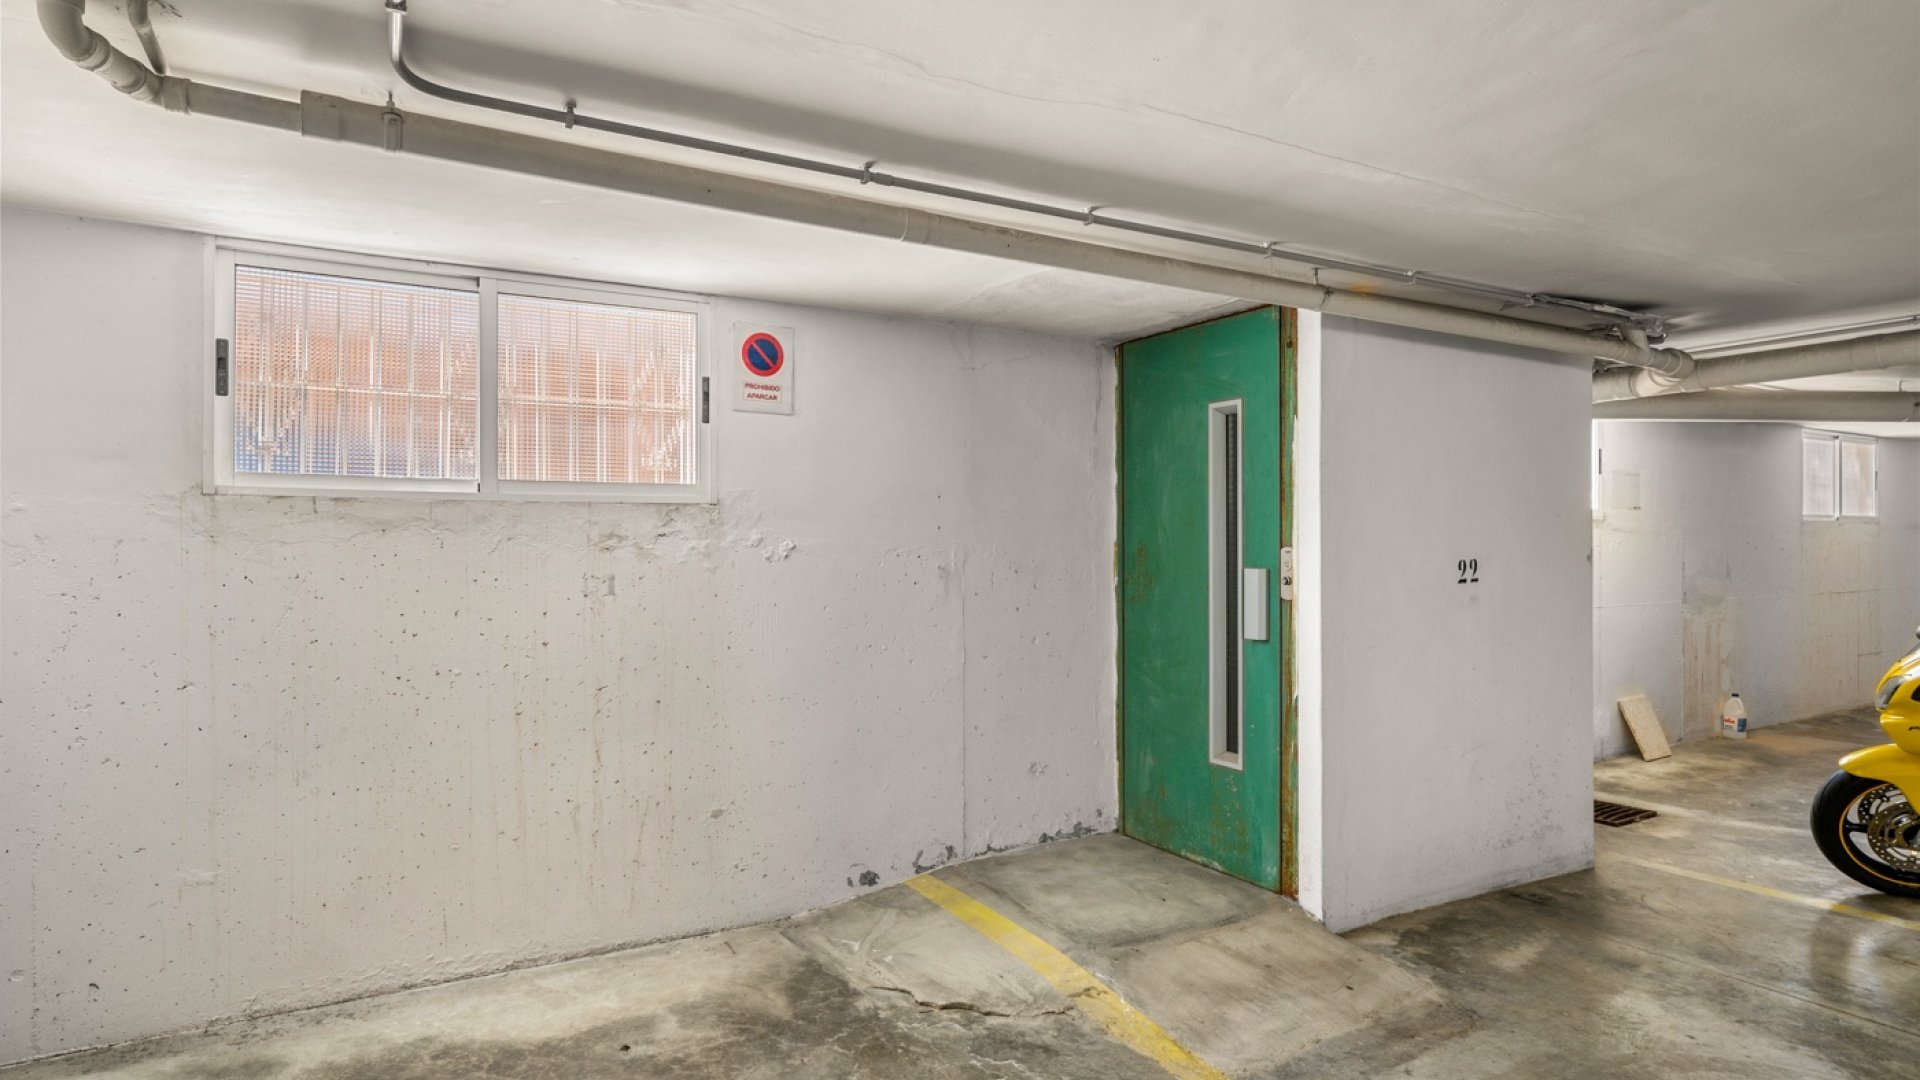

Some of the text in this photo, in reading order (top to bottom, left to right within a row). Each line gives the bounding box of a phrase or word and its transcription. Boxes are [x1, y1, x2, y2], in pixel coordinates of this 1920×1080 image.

[744, 382, 781, 392] PROHIBIDO
[746, 392, 778, 401] APARCAR
[1457, 559, 1479, 584] 22
